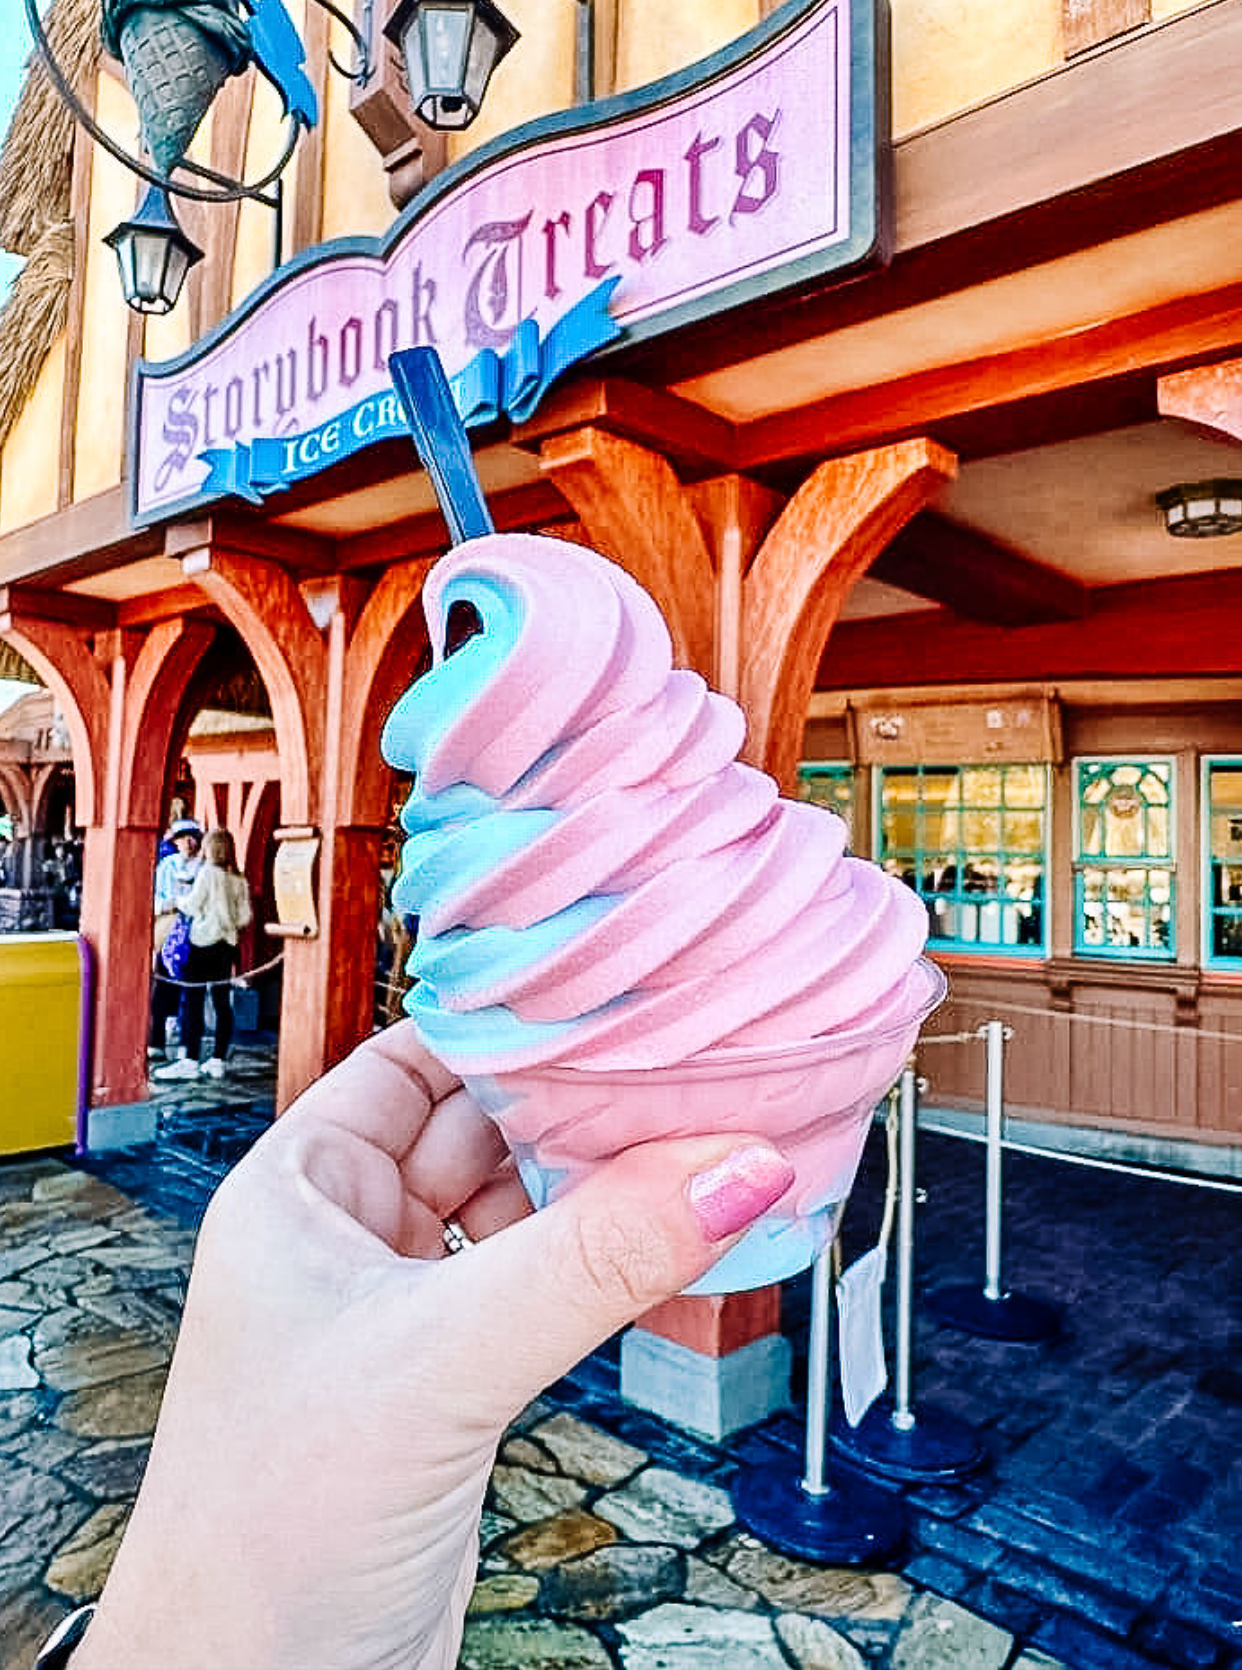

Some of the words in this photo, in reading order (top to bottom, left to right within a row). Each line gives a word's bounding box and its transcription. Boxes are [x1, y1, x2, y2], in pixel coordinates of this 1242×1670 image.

[154, 259, 437, 491] Storybook
[463, 107, 782, 348] Treats
[282, 422, 341, 474] ICE
